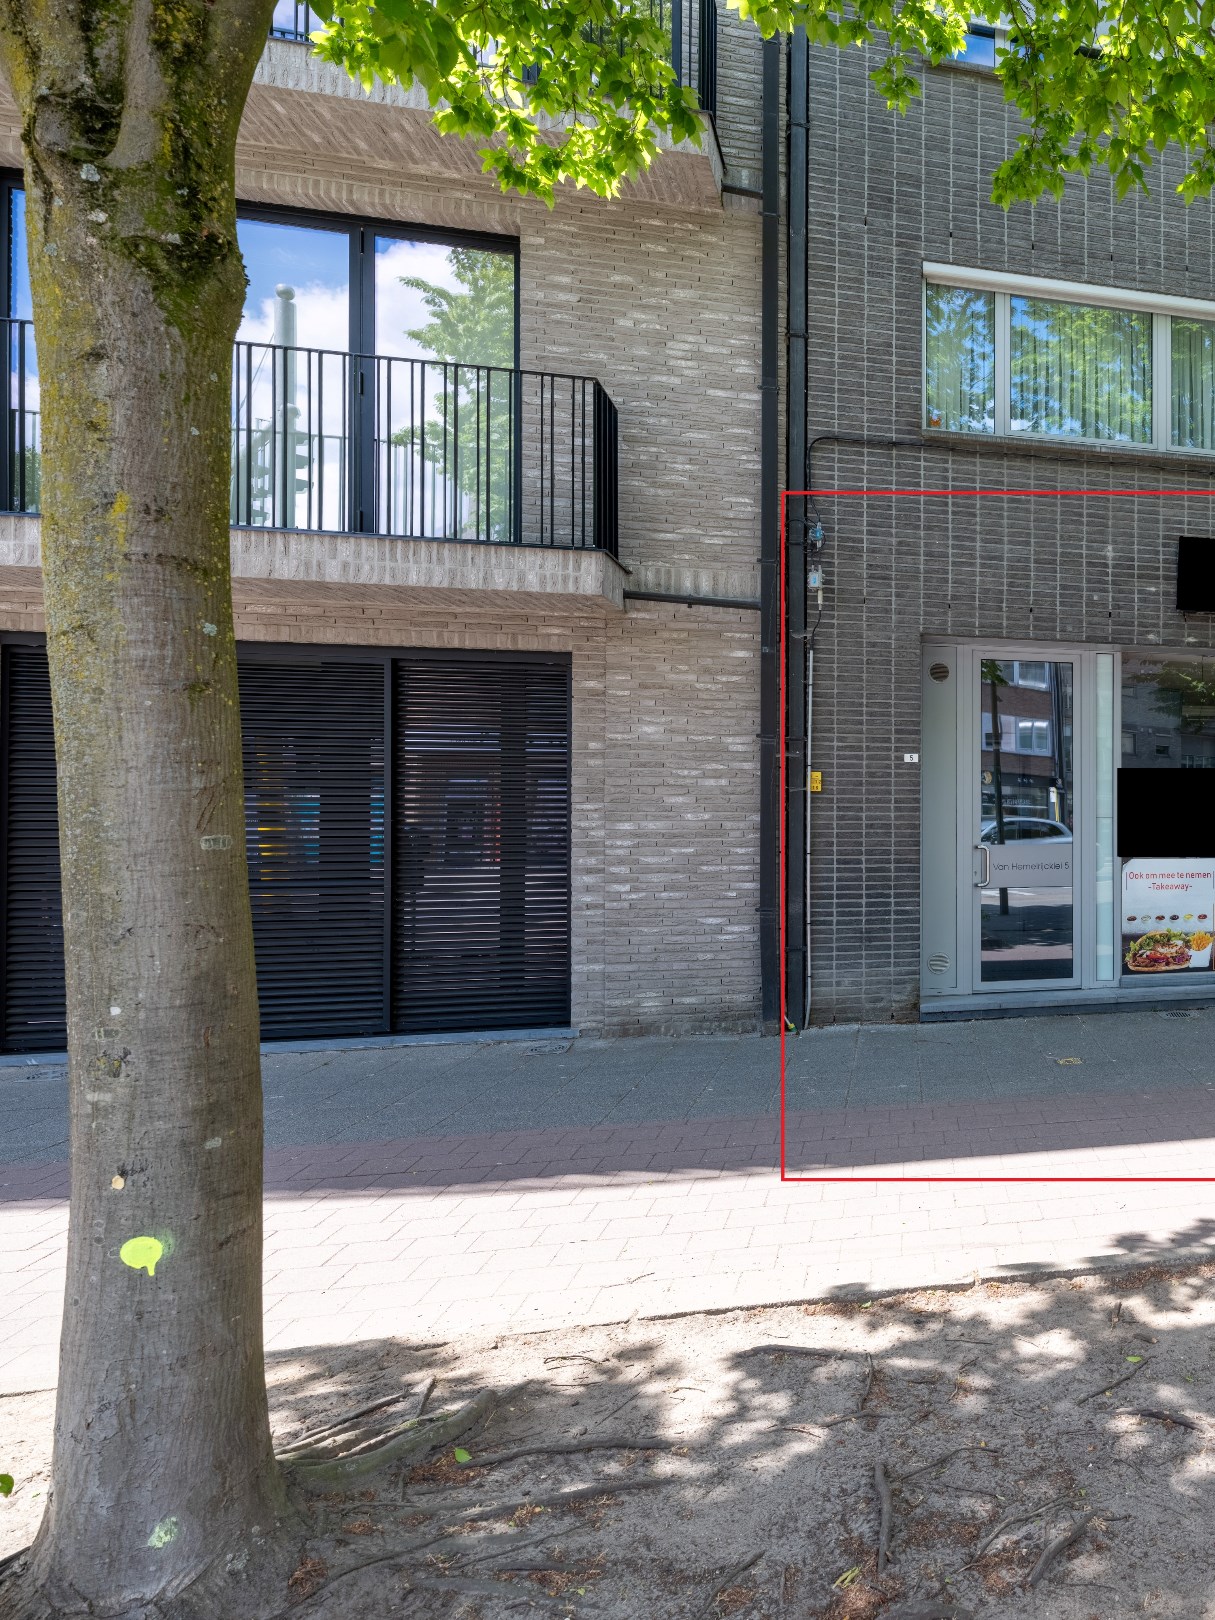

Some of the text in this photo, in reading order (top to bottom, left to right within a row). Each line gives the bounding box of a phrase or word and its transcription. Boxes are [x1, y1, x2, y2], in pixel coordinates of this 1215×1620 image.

[992, 863, 1010, 871] Van
[1064, 861, 1070, 870] 5
[1128, 871, 1144, 880] Ook
